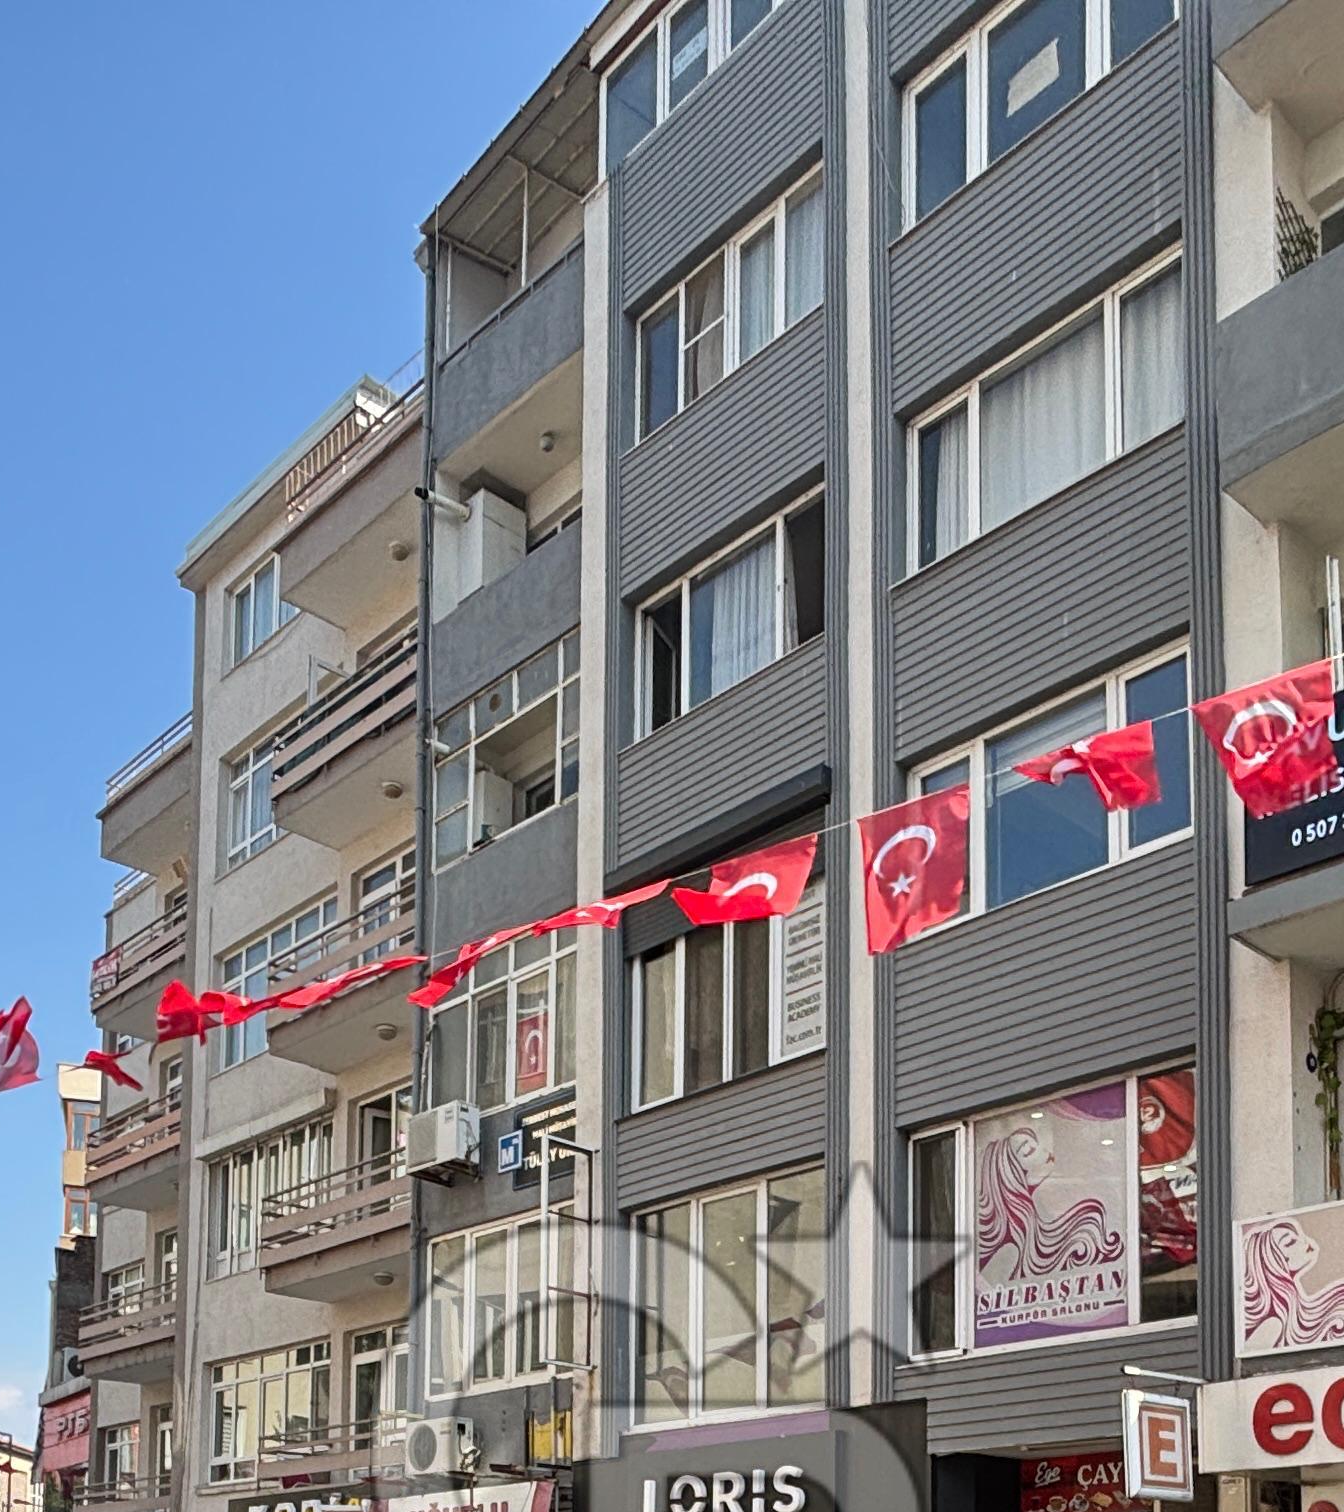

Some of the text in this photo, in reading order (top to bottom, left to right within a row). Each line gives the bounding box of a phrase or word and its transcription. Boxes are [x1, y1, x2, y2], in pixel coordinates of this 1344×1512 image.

[1290, 828, 1303, 848] 0
[1305, 814, 1340, 844] 507
[978, 1268, 1126, 1313] SİLBAŞTAN
[1076, 1461, 1123, 1491] ÇAY
